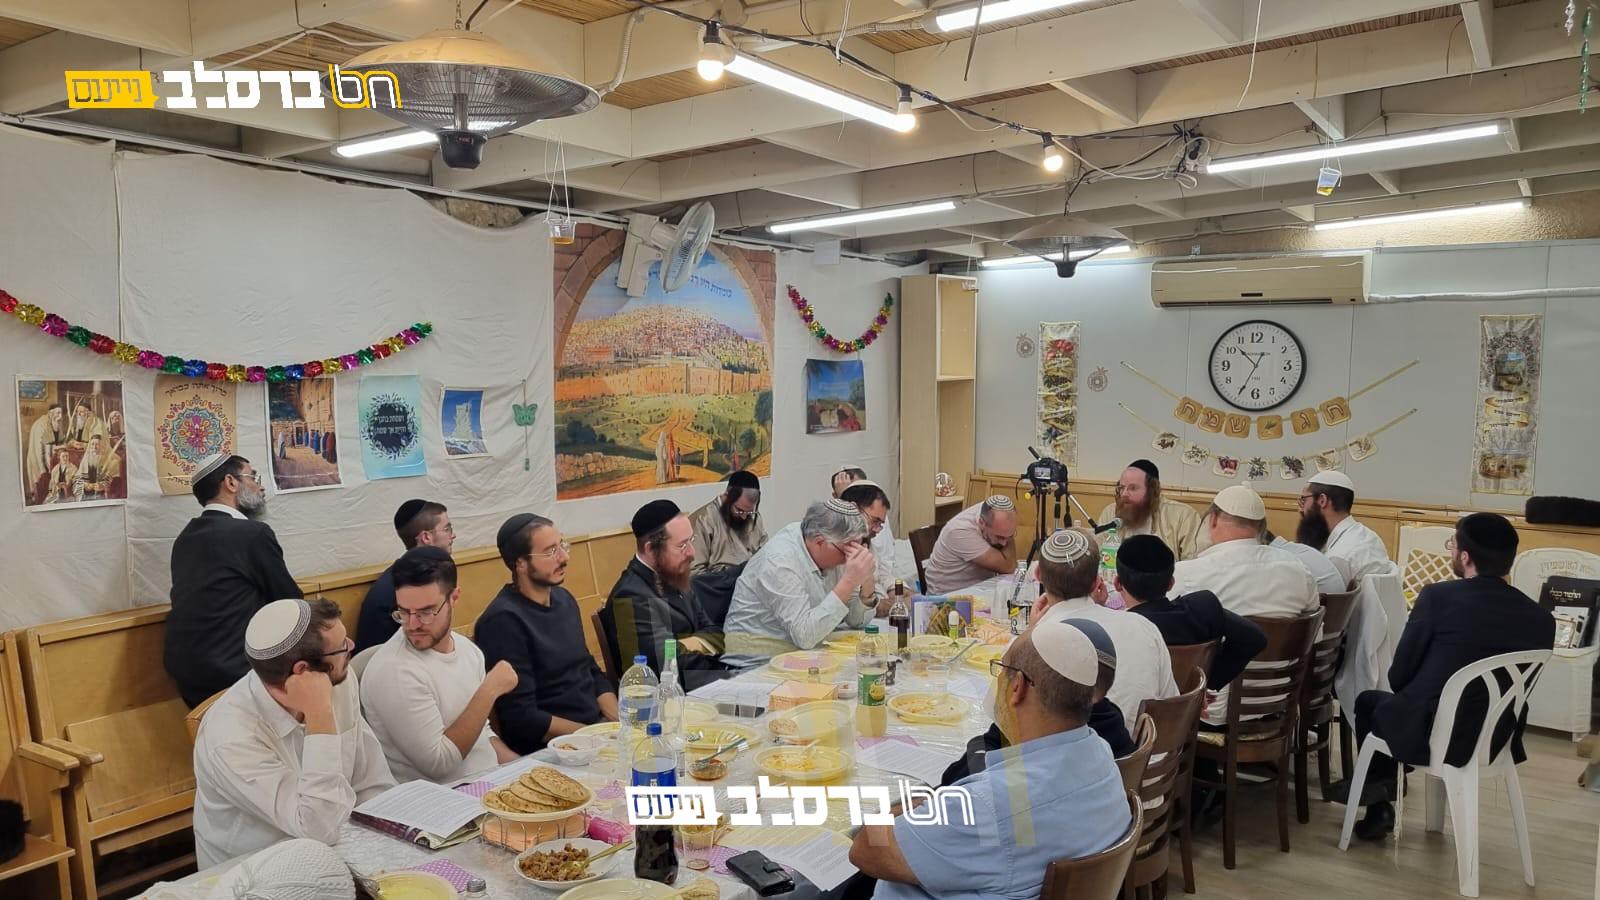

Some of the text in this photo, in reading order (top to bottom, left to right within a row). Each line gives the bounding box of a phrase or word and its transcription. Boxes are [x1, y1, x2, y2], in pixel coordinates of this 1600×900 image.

[1238, 336, 1245, 345] 11
[1250, 332, 1264, 344] 12
[1226, 347, 1237, 355] 10
[1281, 346, 1288, 354] 2
[1222, 360, 1231, 372] 9
[1283, 360, 1292, 372] 3
[1225, 376, 1232, 384] 8
[1280, 376, 1287, 385] 4
[1251, 388, 1260, 400] 6
[1269, 387, 1275, 396] 5
[1180, 402, 1345, 433] חג שמח
